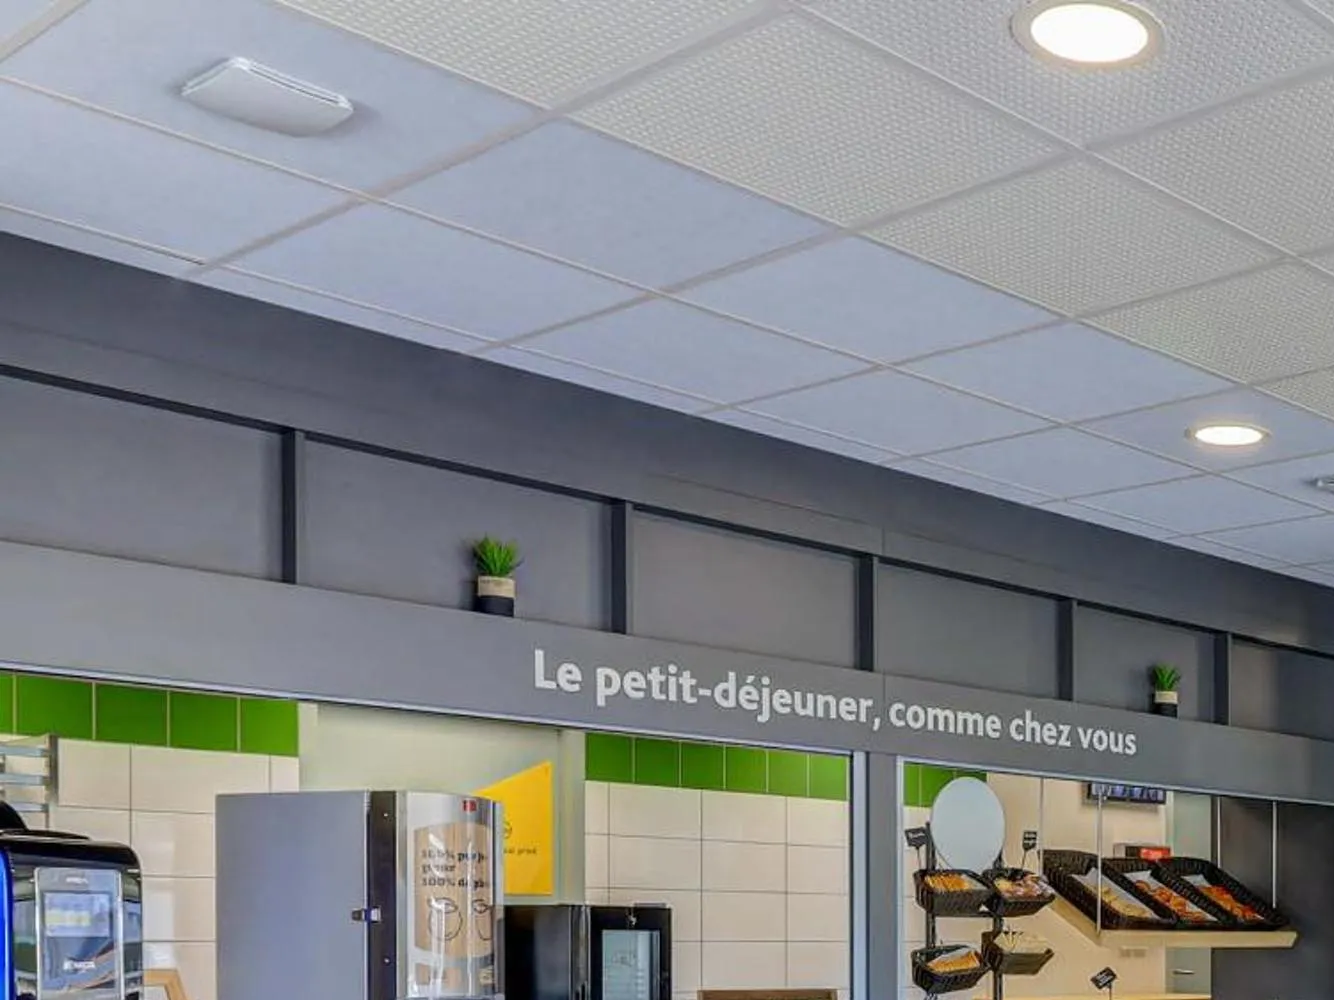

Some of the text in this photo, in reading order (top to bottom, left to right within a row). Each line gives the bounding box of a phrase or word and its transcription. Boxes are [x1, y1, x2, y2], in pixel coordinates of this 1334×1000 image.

[534, 649, 1137, 755] Le petit-déjeuner, comme chez vous
